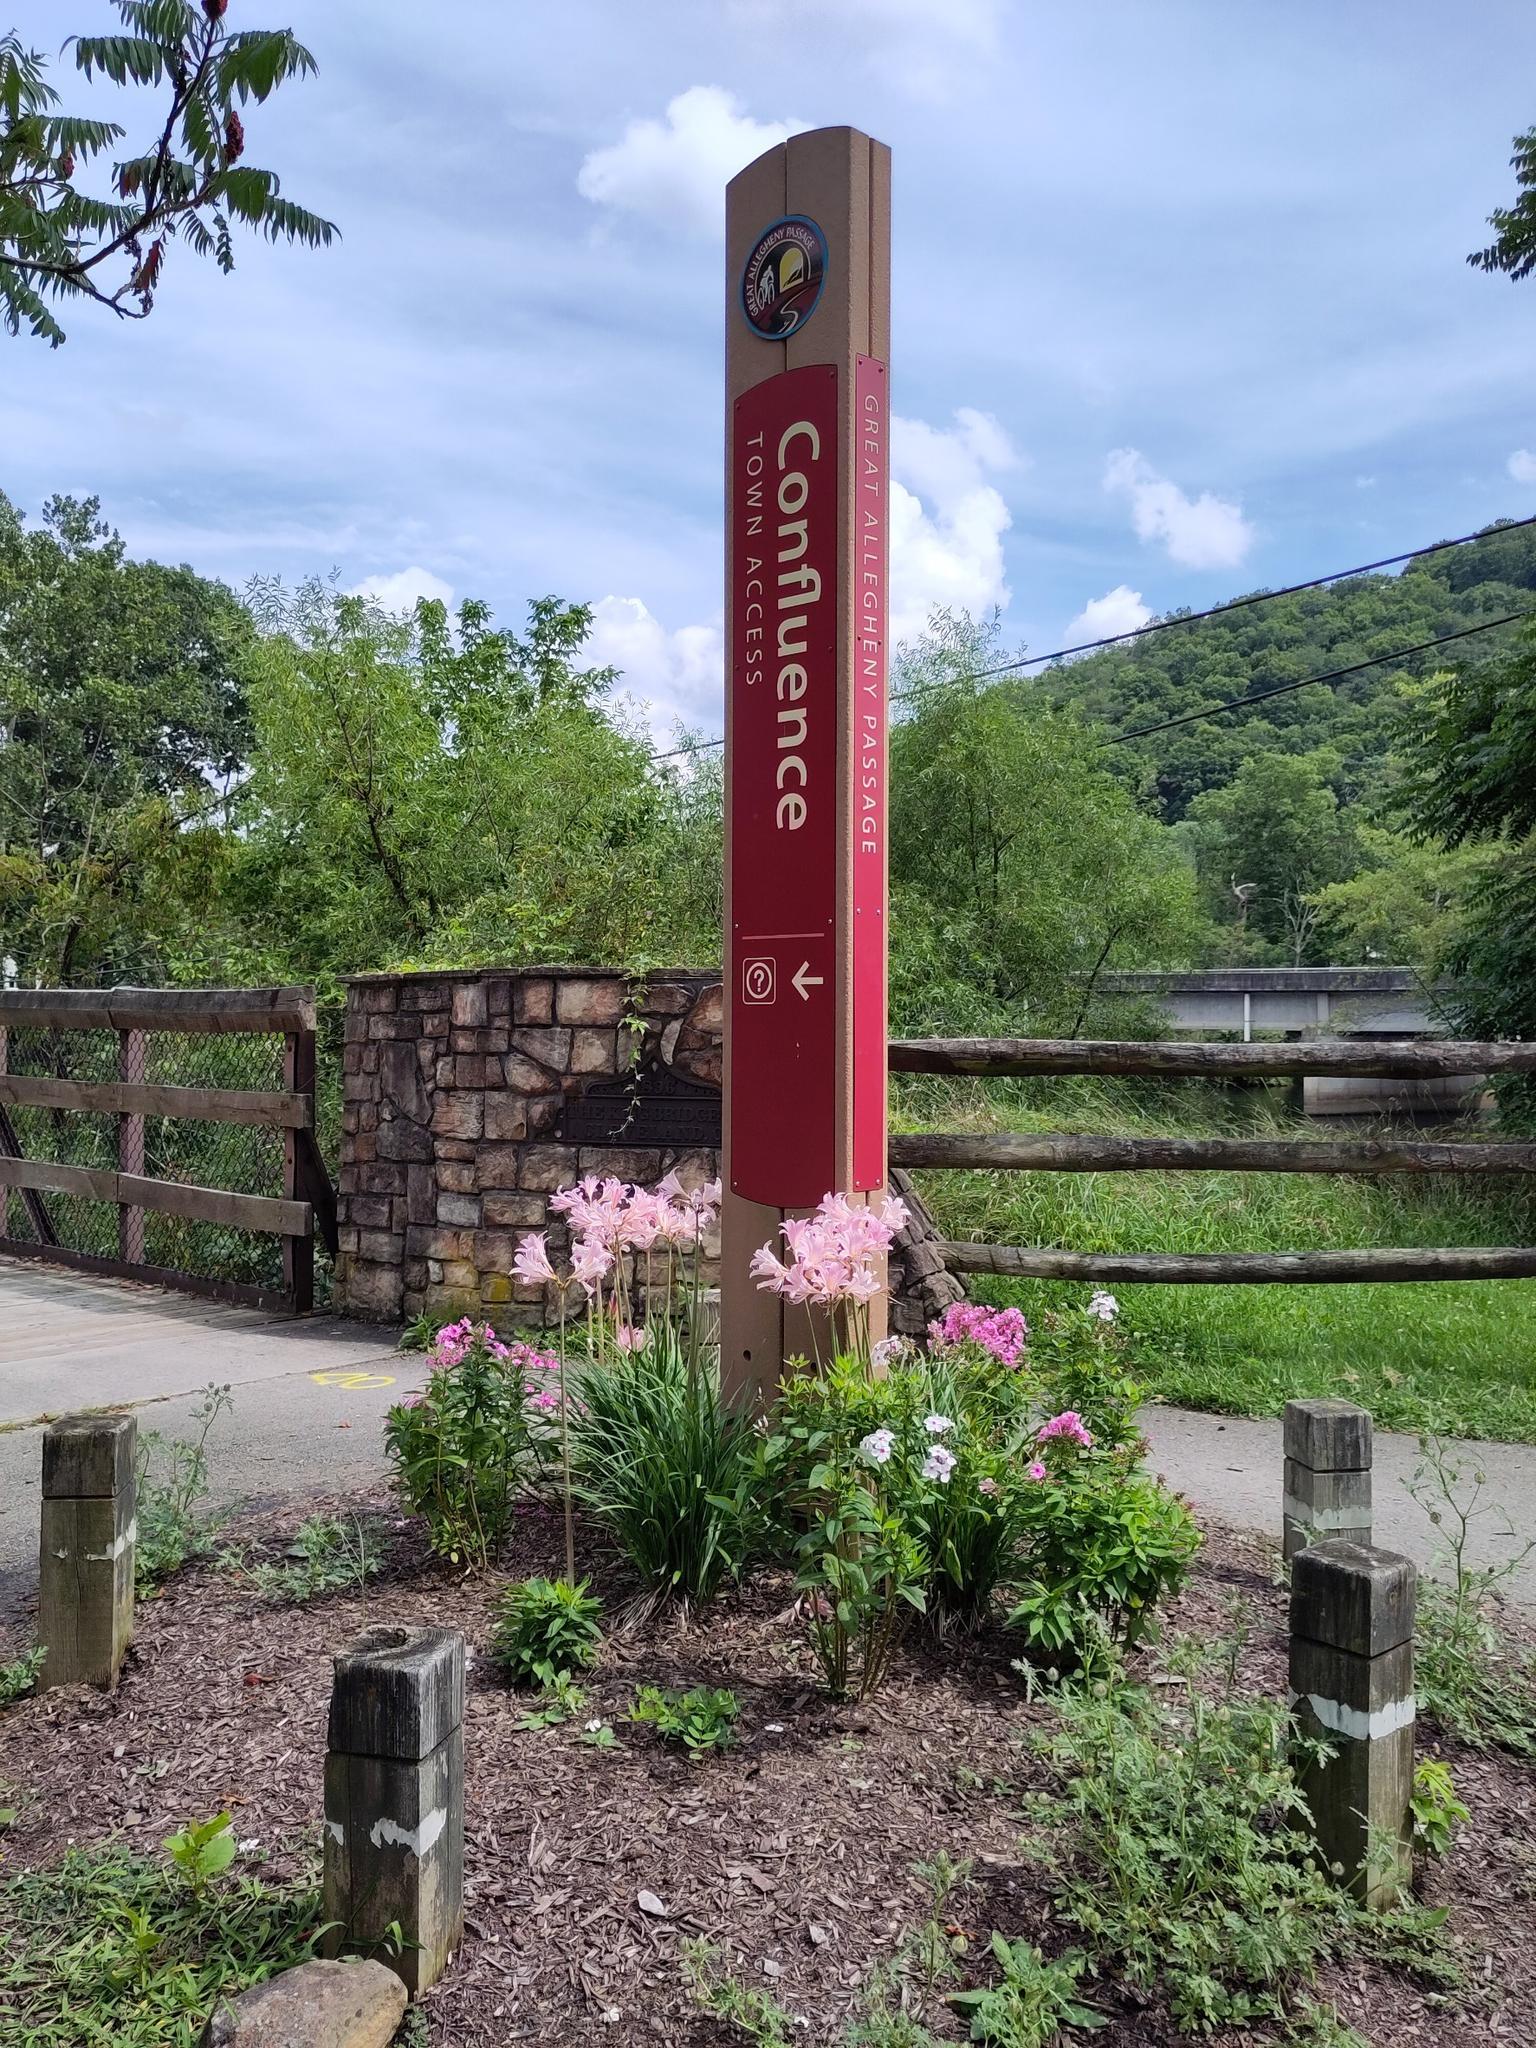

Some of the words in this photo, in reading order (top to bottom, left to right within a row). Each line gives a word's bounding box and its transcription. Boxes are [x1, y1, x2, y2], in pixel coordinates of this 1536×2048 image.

[748, 229, 786, 279] ALLEGHENY
[785, 226, 816, 250] PASSAGE
[746, 284, 759, 316] GREAT
[746, 431, 763, 536] TOWN
[863, 394, 879, 496] GREAT
[746, 557, 763, 685] ACCESS
[776, 420, 822, 831] Confluence
[863, 510, 879, 698] ALLEGHENY
[862, 715, 877, 854] PASSAGE
